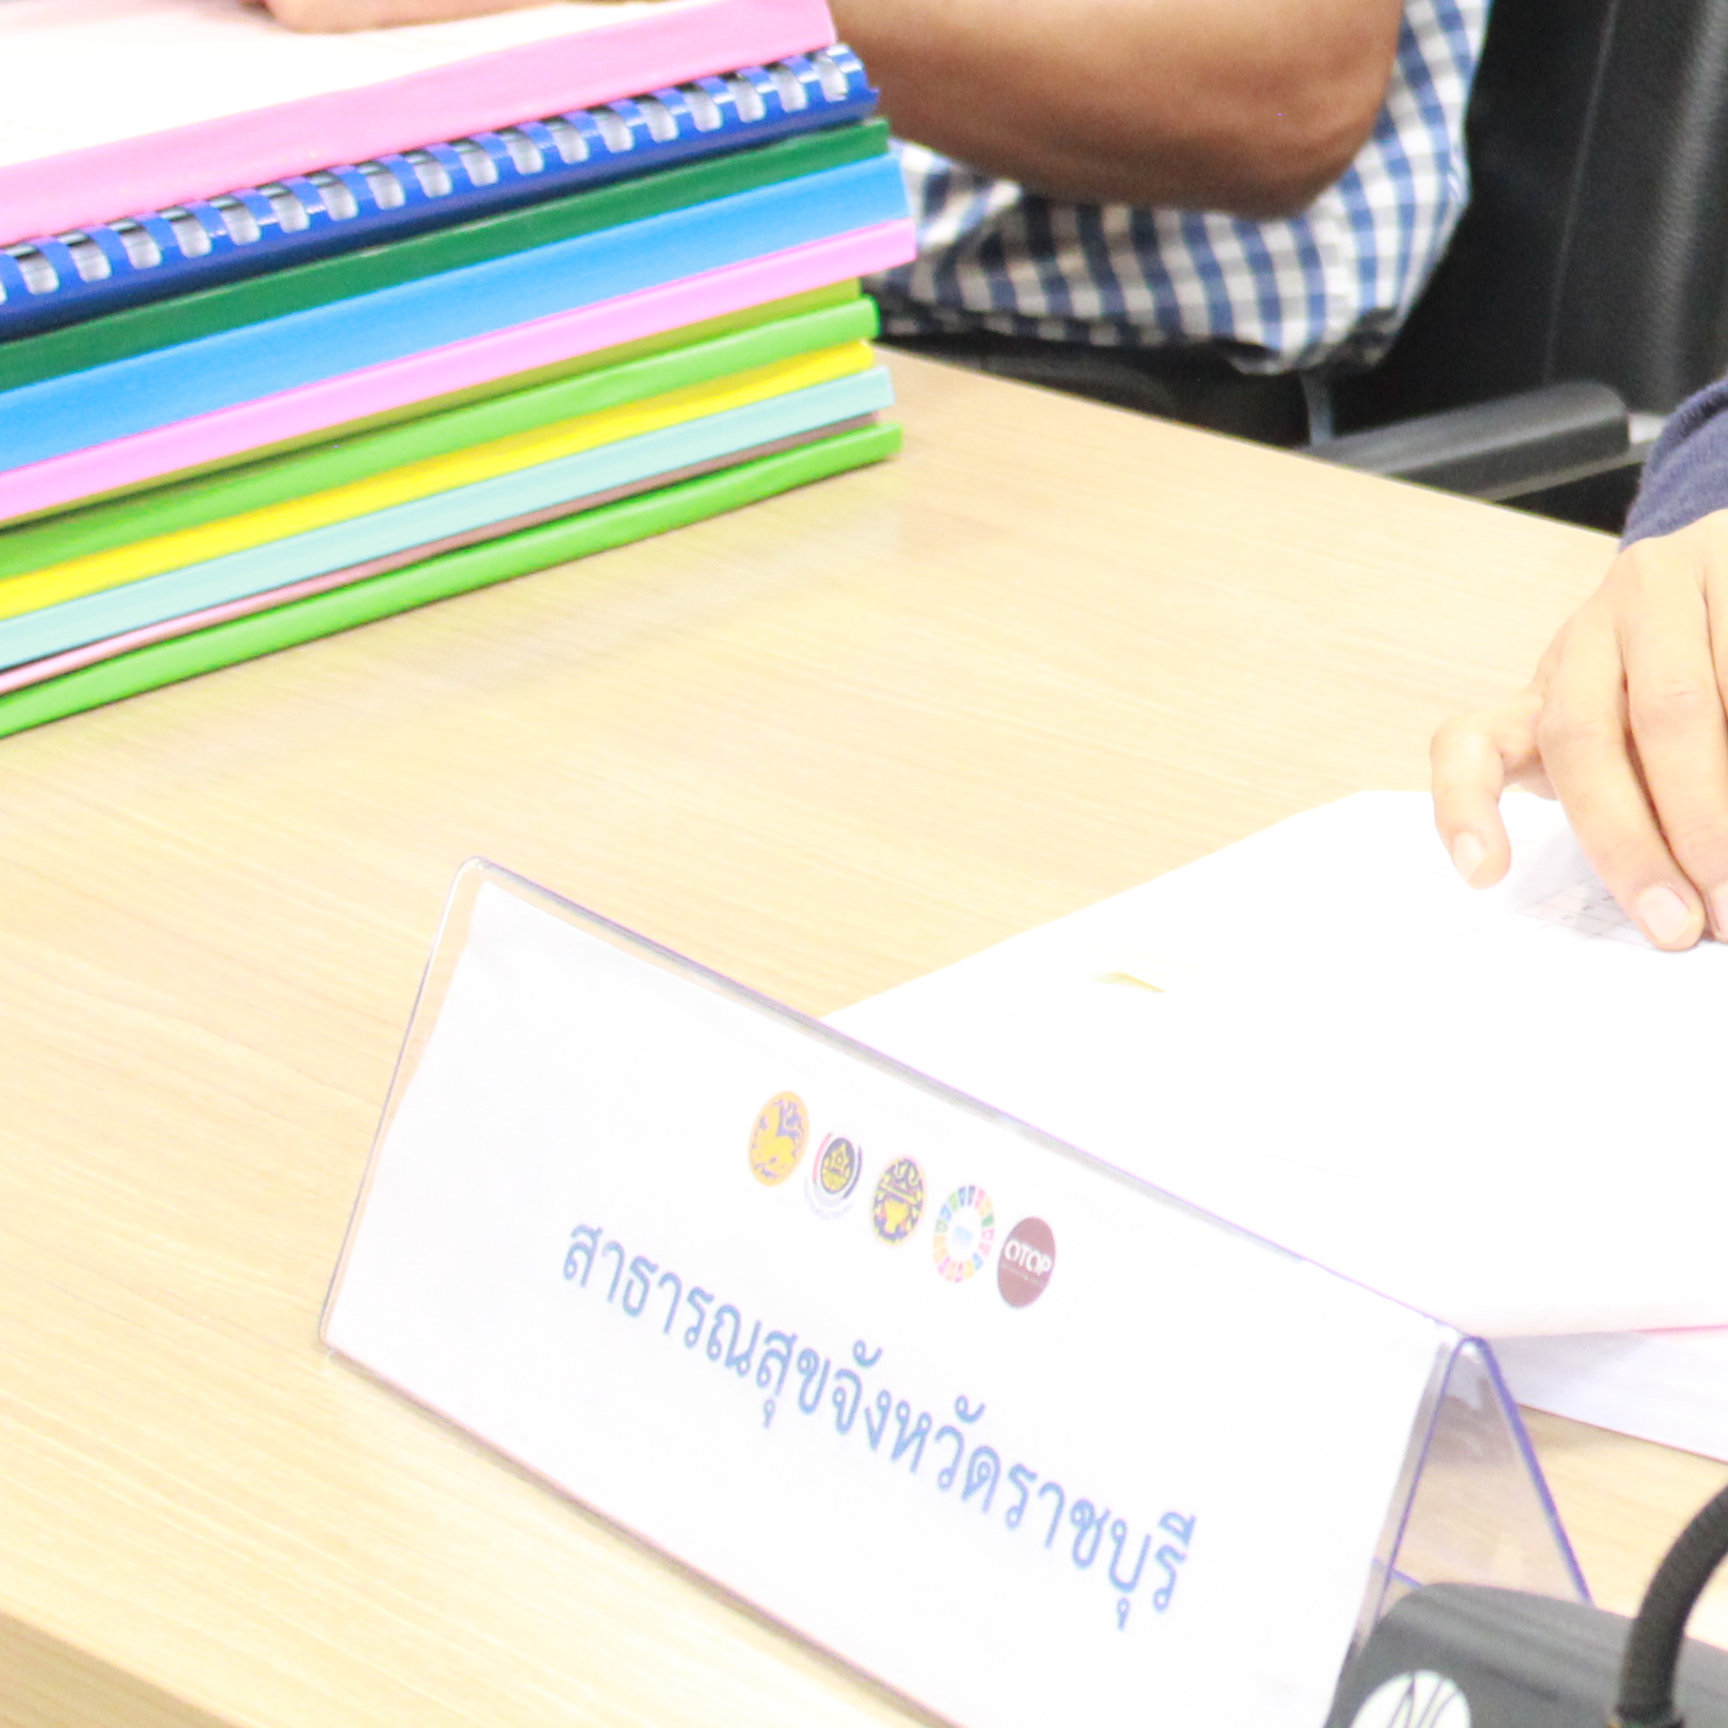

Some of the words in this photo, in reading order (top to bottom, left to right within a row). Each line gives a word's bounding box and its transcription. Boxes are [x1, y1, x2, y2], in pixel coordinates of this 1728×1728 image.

[1004, 1238, 1052, 1277] OTOP
[561, 1222, 1198, 1630] สาธารณสุขจังหวัดราชบุรี
